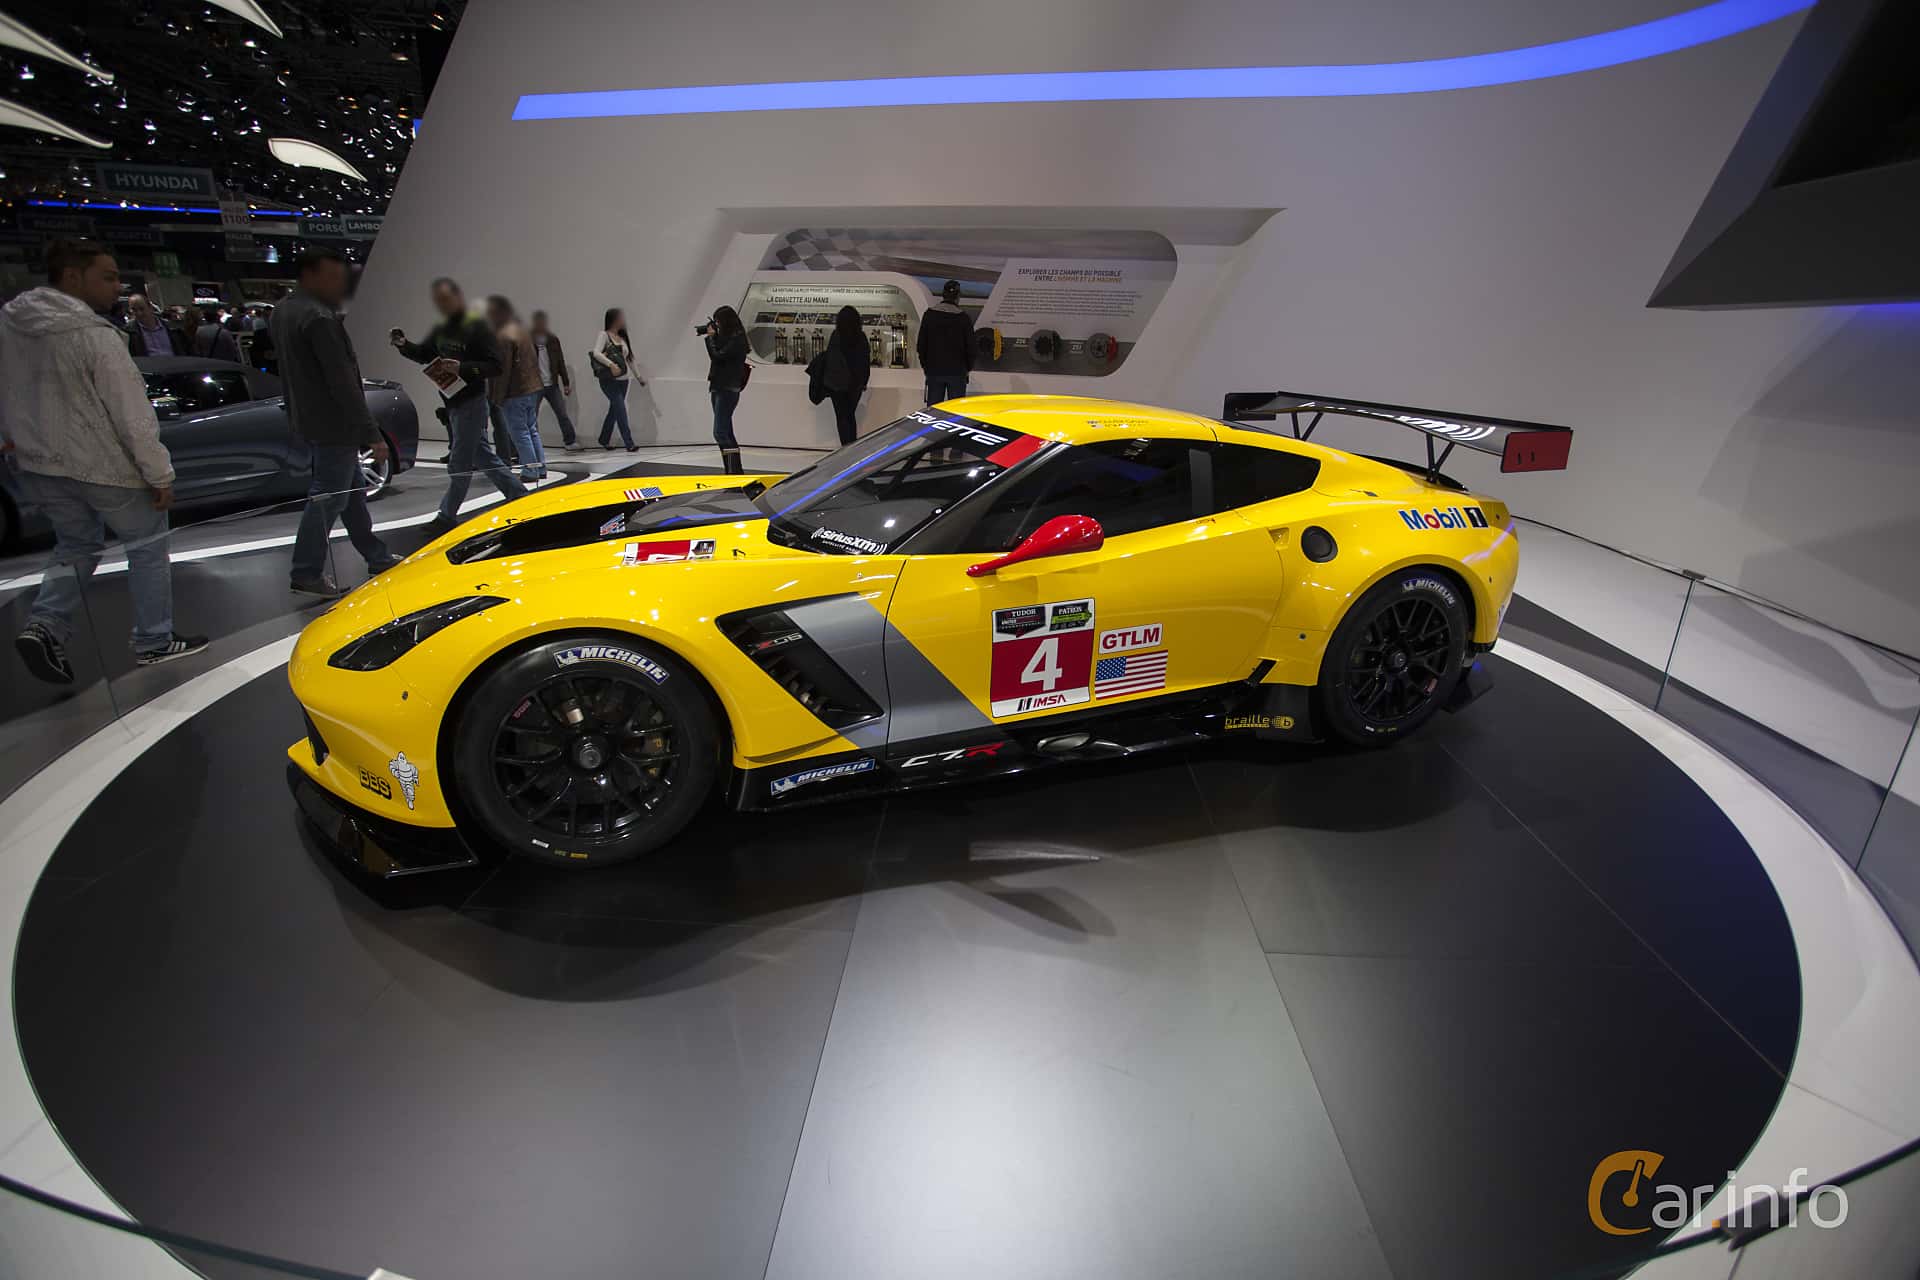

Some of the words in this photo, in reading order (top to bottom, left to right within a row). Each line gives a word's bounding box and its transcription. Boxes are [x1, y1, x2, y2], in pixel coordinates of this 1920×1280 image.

[114, 172, 200, 191] HYUNDAI
[1398, 506, 1468, 531] Mobil
[1415, 578, 1456, 606] MICHELIN
[1011, 608, 1037, 617] TUDOR
[1102, 626, 1160, 650] GTLM
[580, 646, 667, 680] MICHELIN
[1020, 637, 1063, 691] 4
[1033, 694, 1067, 708] IMSA
[1225, 713, 1270, 725] braille
[360, 767, 392, 800] BBS
[796, 761, 870, 783] MICHELIN
